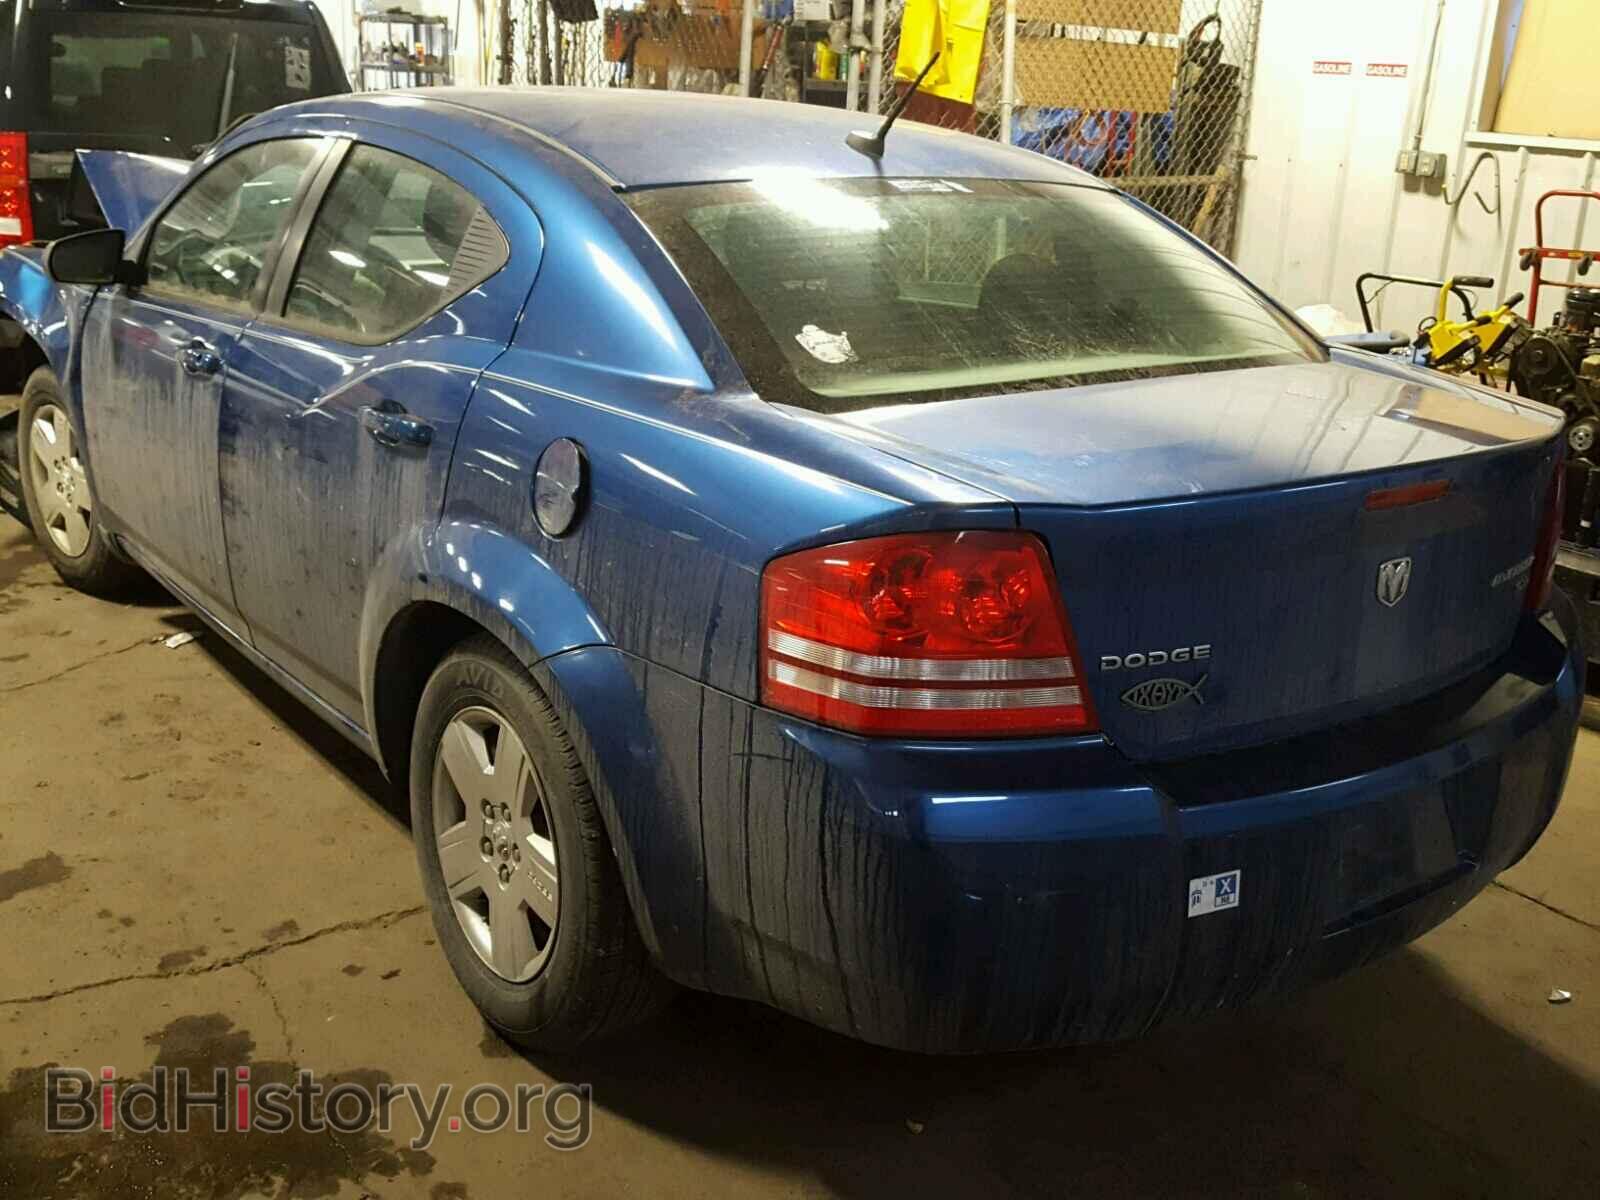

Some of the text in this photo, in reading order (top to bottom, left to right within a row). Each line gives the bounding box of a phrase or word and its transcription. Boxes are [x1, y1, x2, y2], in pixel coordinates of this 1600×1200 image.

[1313, 62, 1351, 74] GASOLINE
[1366, 64, 1407, 77] GASOLINE
[1101, 644, 1211, 671] DODGE
